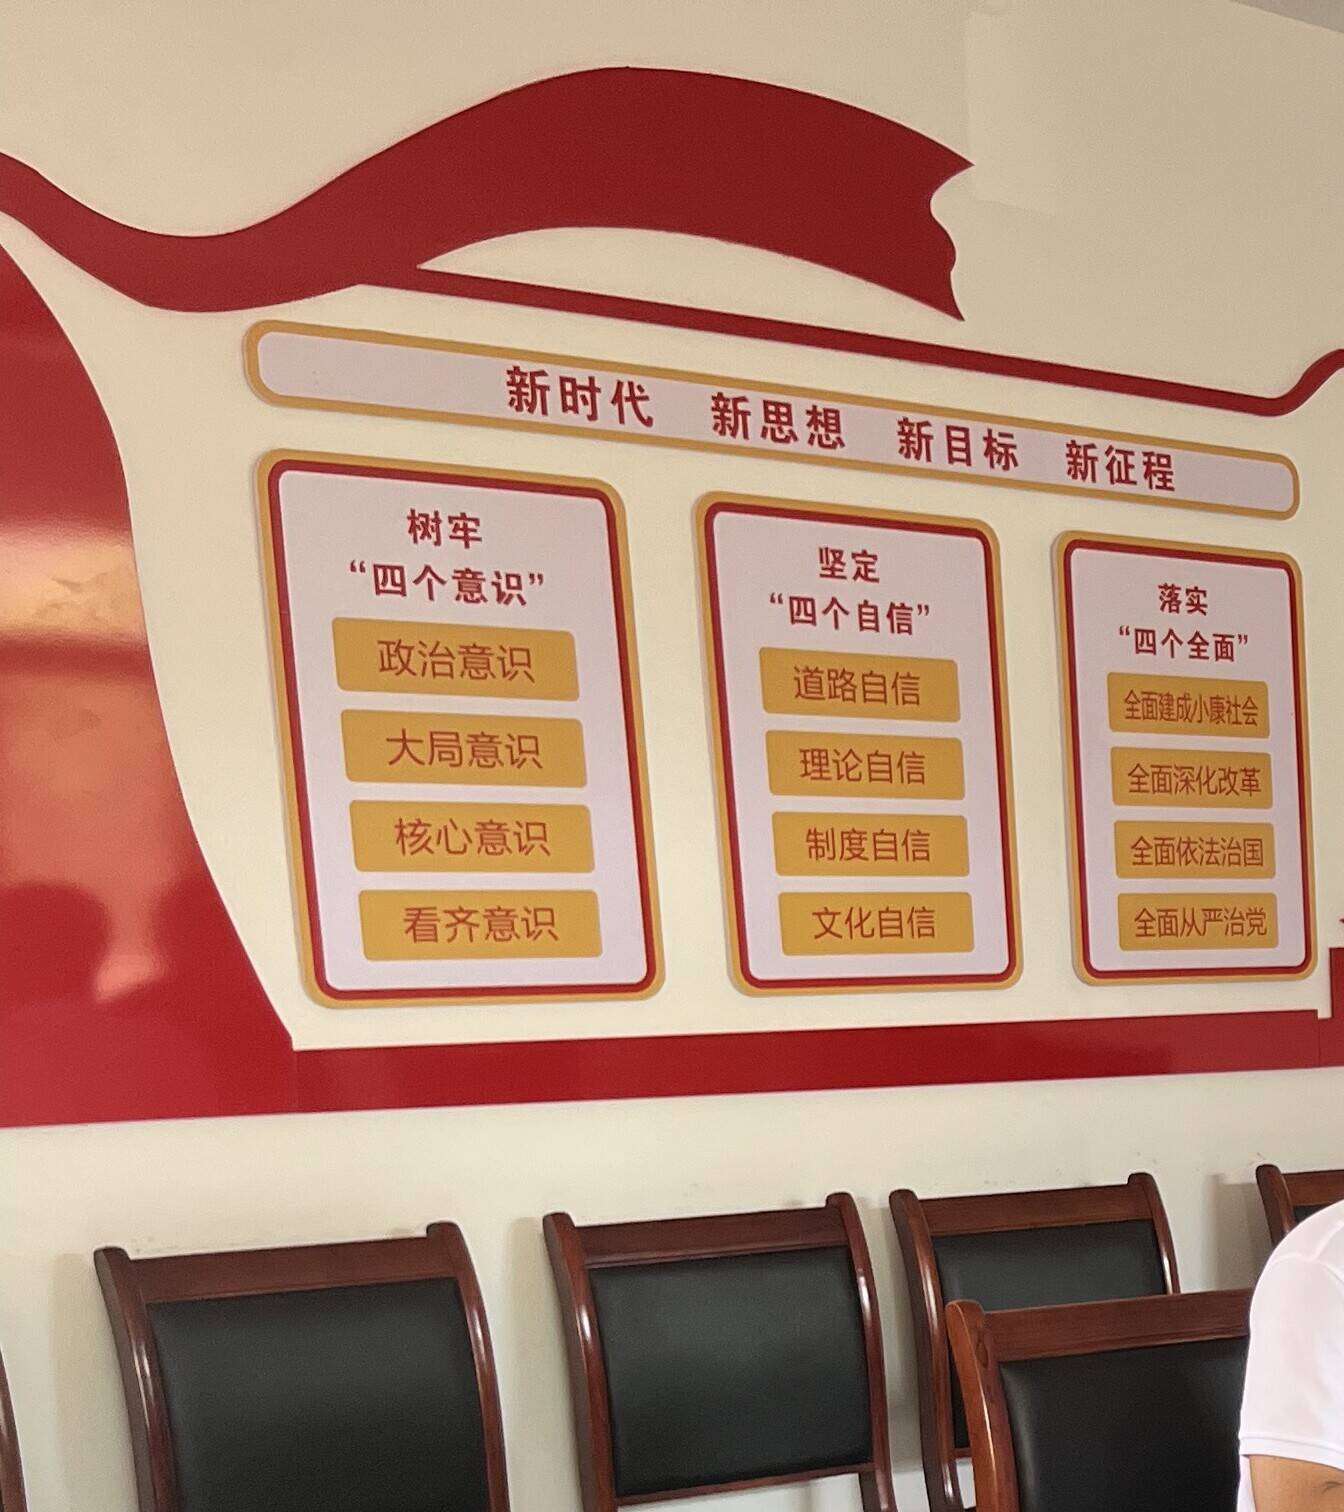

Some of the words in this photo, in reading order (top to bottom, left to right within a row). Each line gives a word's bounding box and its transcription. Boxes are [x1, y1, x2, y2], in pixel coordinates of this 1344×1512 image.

[505, 364, 655, 430] 新时代
[709, 391, 846, 451] 新思想
[896, 415, 1020, 472] 新目标
[1064, 439, 1177, 493] 新征程
[405, 508, 483, 549] 树牢
[819, 546, 881, 584] 坚定
[1158, 582, 1209, 617] 落实
[376, 639, 536, 684] 政治意识
[793, 666, 922, 707] 道路自信
[1124, 688, 1260, 727] 全面建成小康社会
[386, 728, 544, 771] 大局意识
[799, 747, 927, 786] 理论自信
[1127, 763, 1262, 798] 全面深化改革
[393, 817, 550, 857] 核心意识
[805, 827, 932, 863] 制度自信
[1131, 835, 1265, 868] 全面依法治国
[402, 905, 560, 944] 看齐意识
[812, 906, 937, 941] 文化自信
[1134, 906, 1268, 939] 全面从严治党
